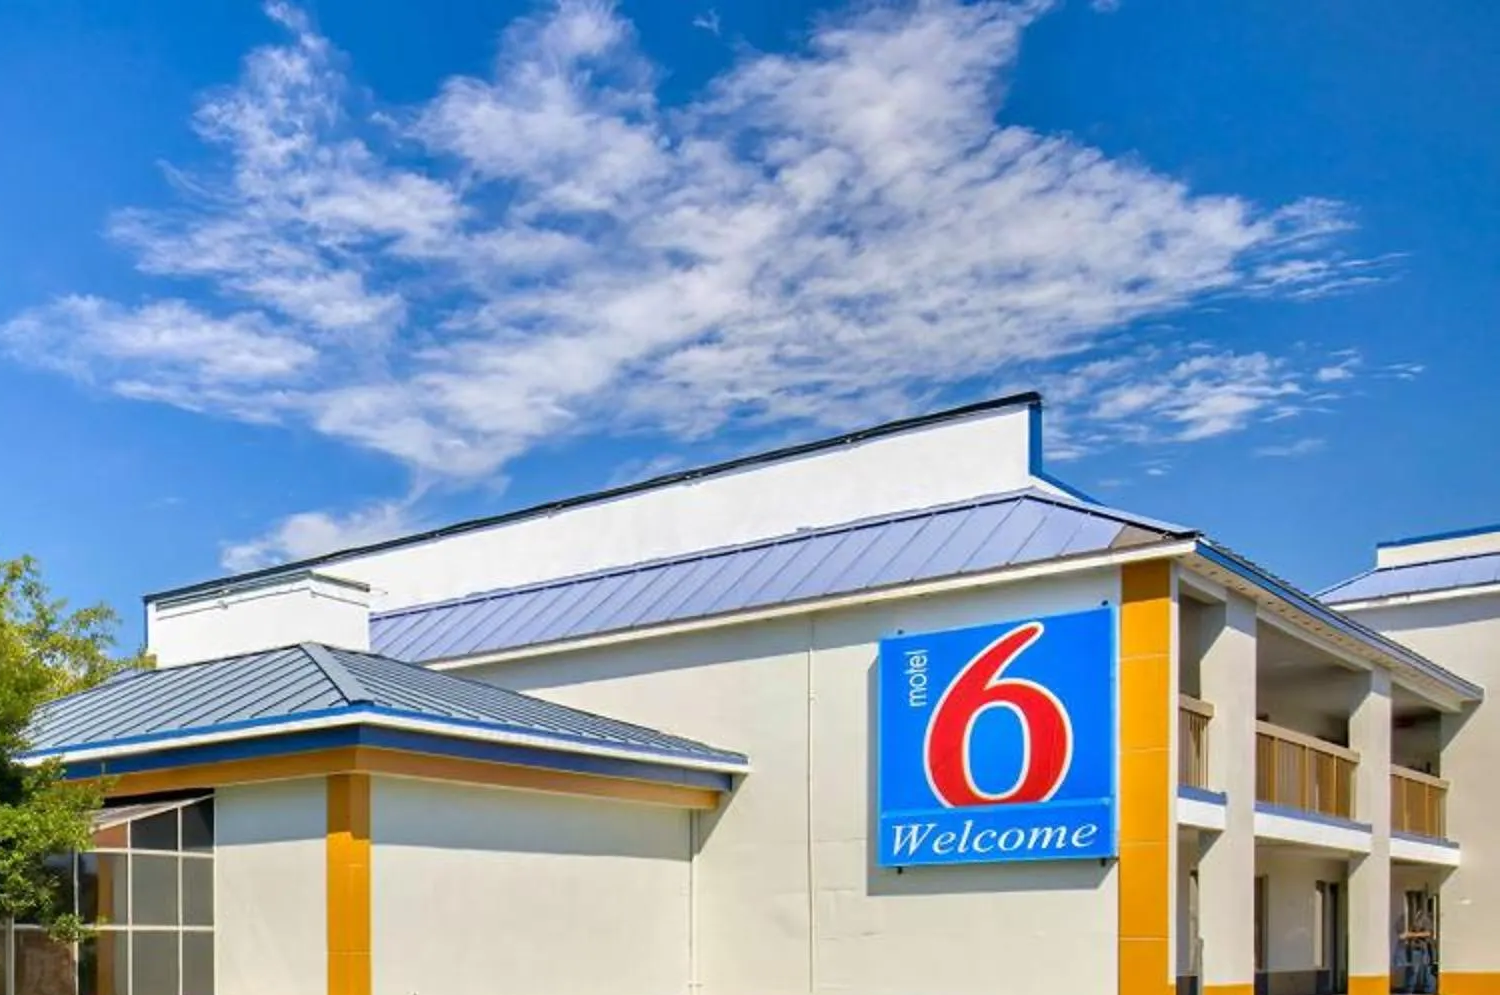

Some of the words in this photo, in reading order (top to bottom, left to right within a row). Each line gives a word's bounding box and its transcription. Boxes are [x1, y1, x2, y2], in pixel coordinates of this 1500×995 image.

[904, 650, 928, 706] motel
[924, 621, 1073, 808] 6
[891, 819, 1098, 857] Welcome
